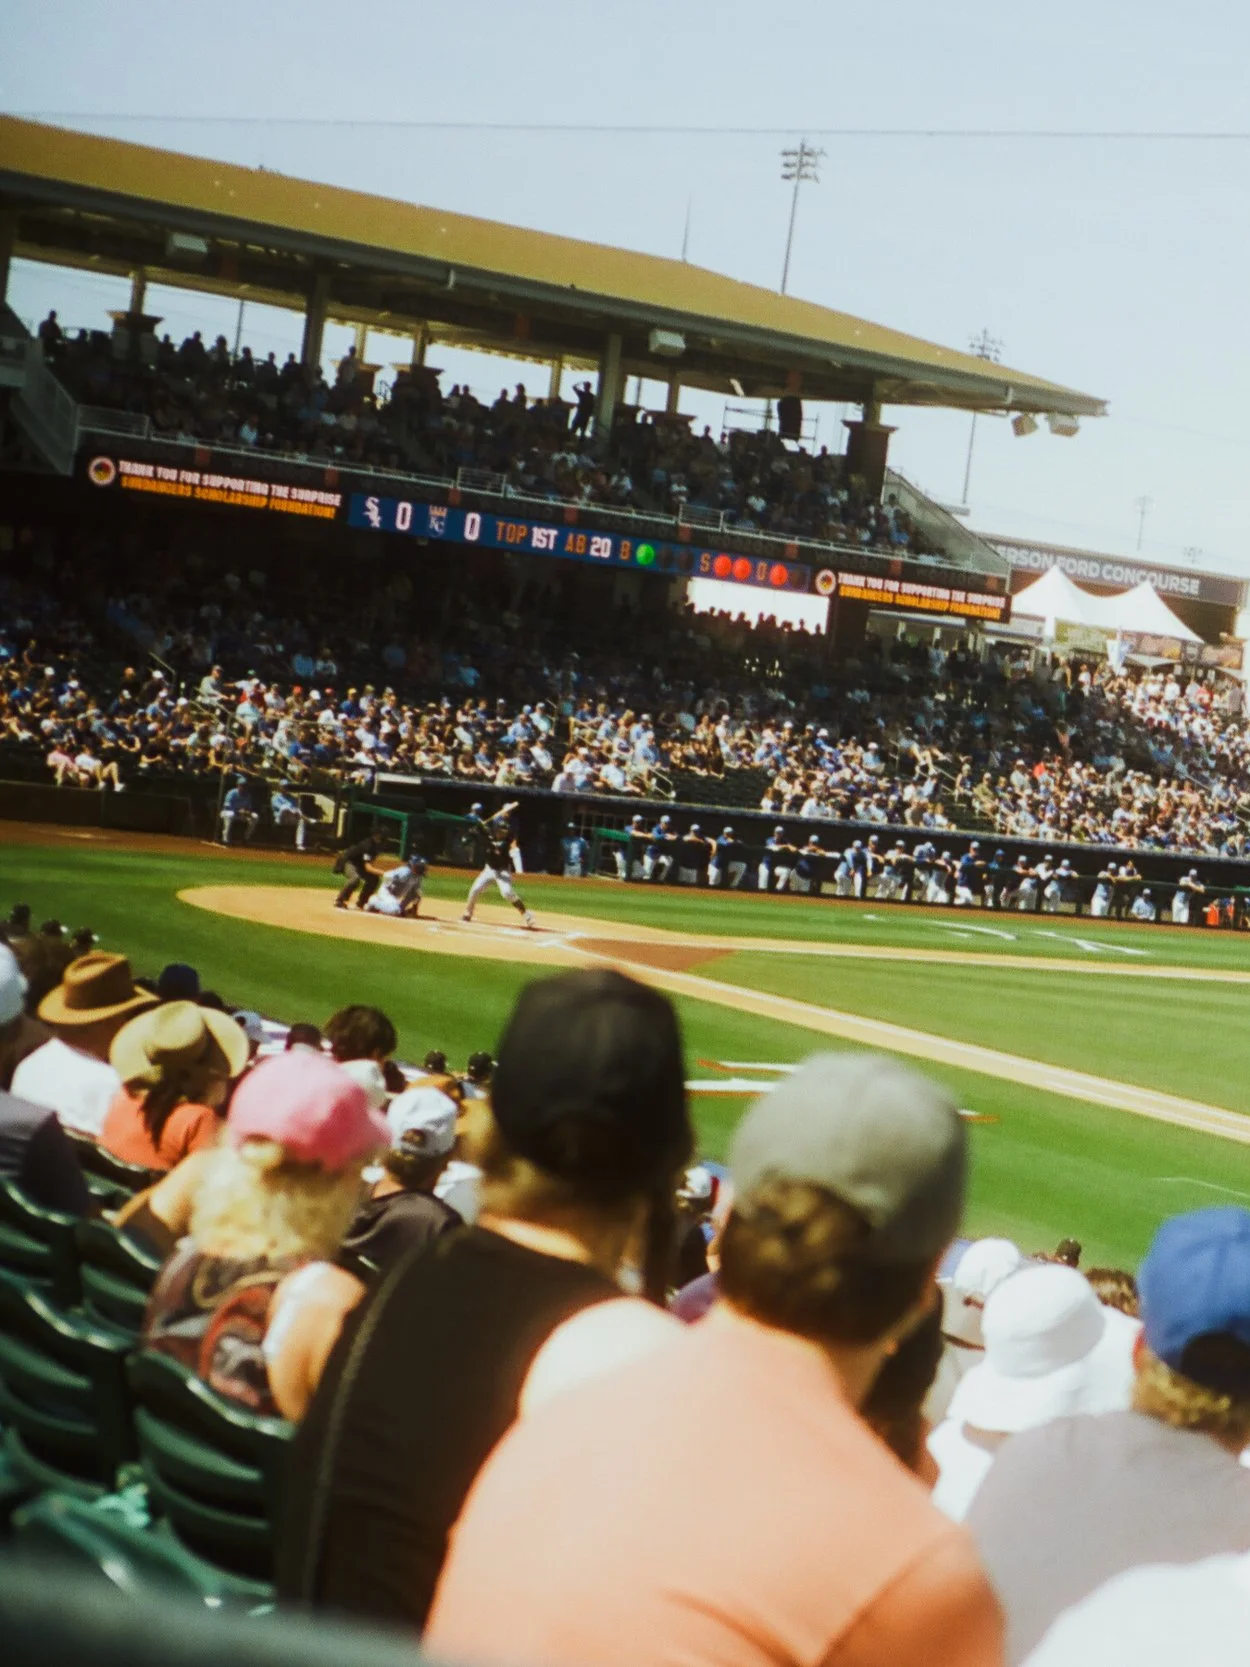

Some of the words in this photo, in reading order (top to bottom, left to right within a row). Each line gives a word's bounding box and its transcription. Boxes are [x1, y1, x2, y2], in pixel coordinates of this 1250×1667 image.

[395, 501, 412, 531] 0
[464, 511, 481, 541] 0
[496, 521, 527, 544] TOP
[531, 526, 559, 550] 1ST
[565, 533, 587, 555] AB
[589, 535, 612, 558] 20
[1056, 555, 1100, 579] FORD
[1102, 563, 1200, 595] CONCOURSE
